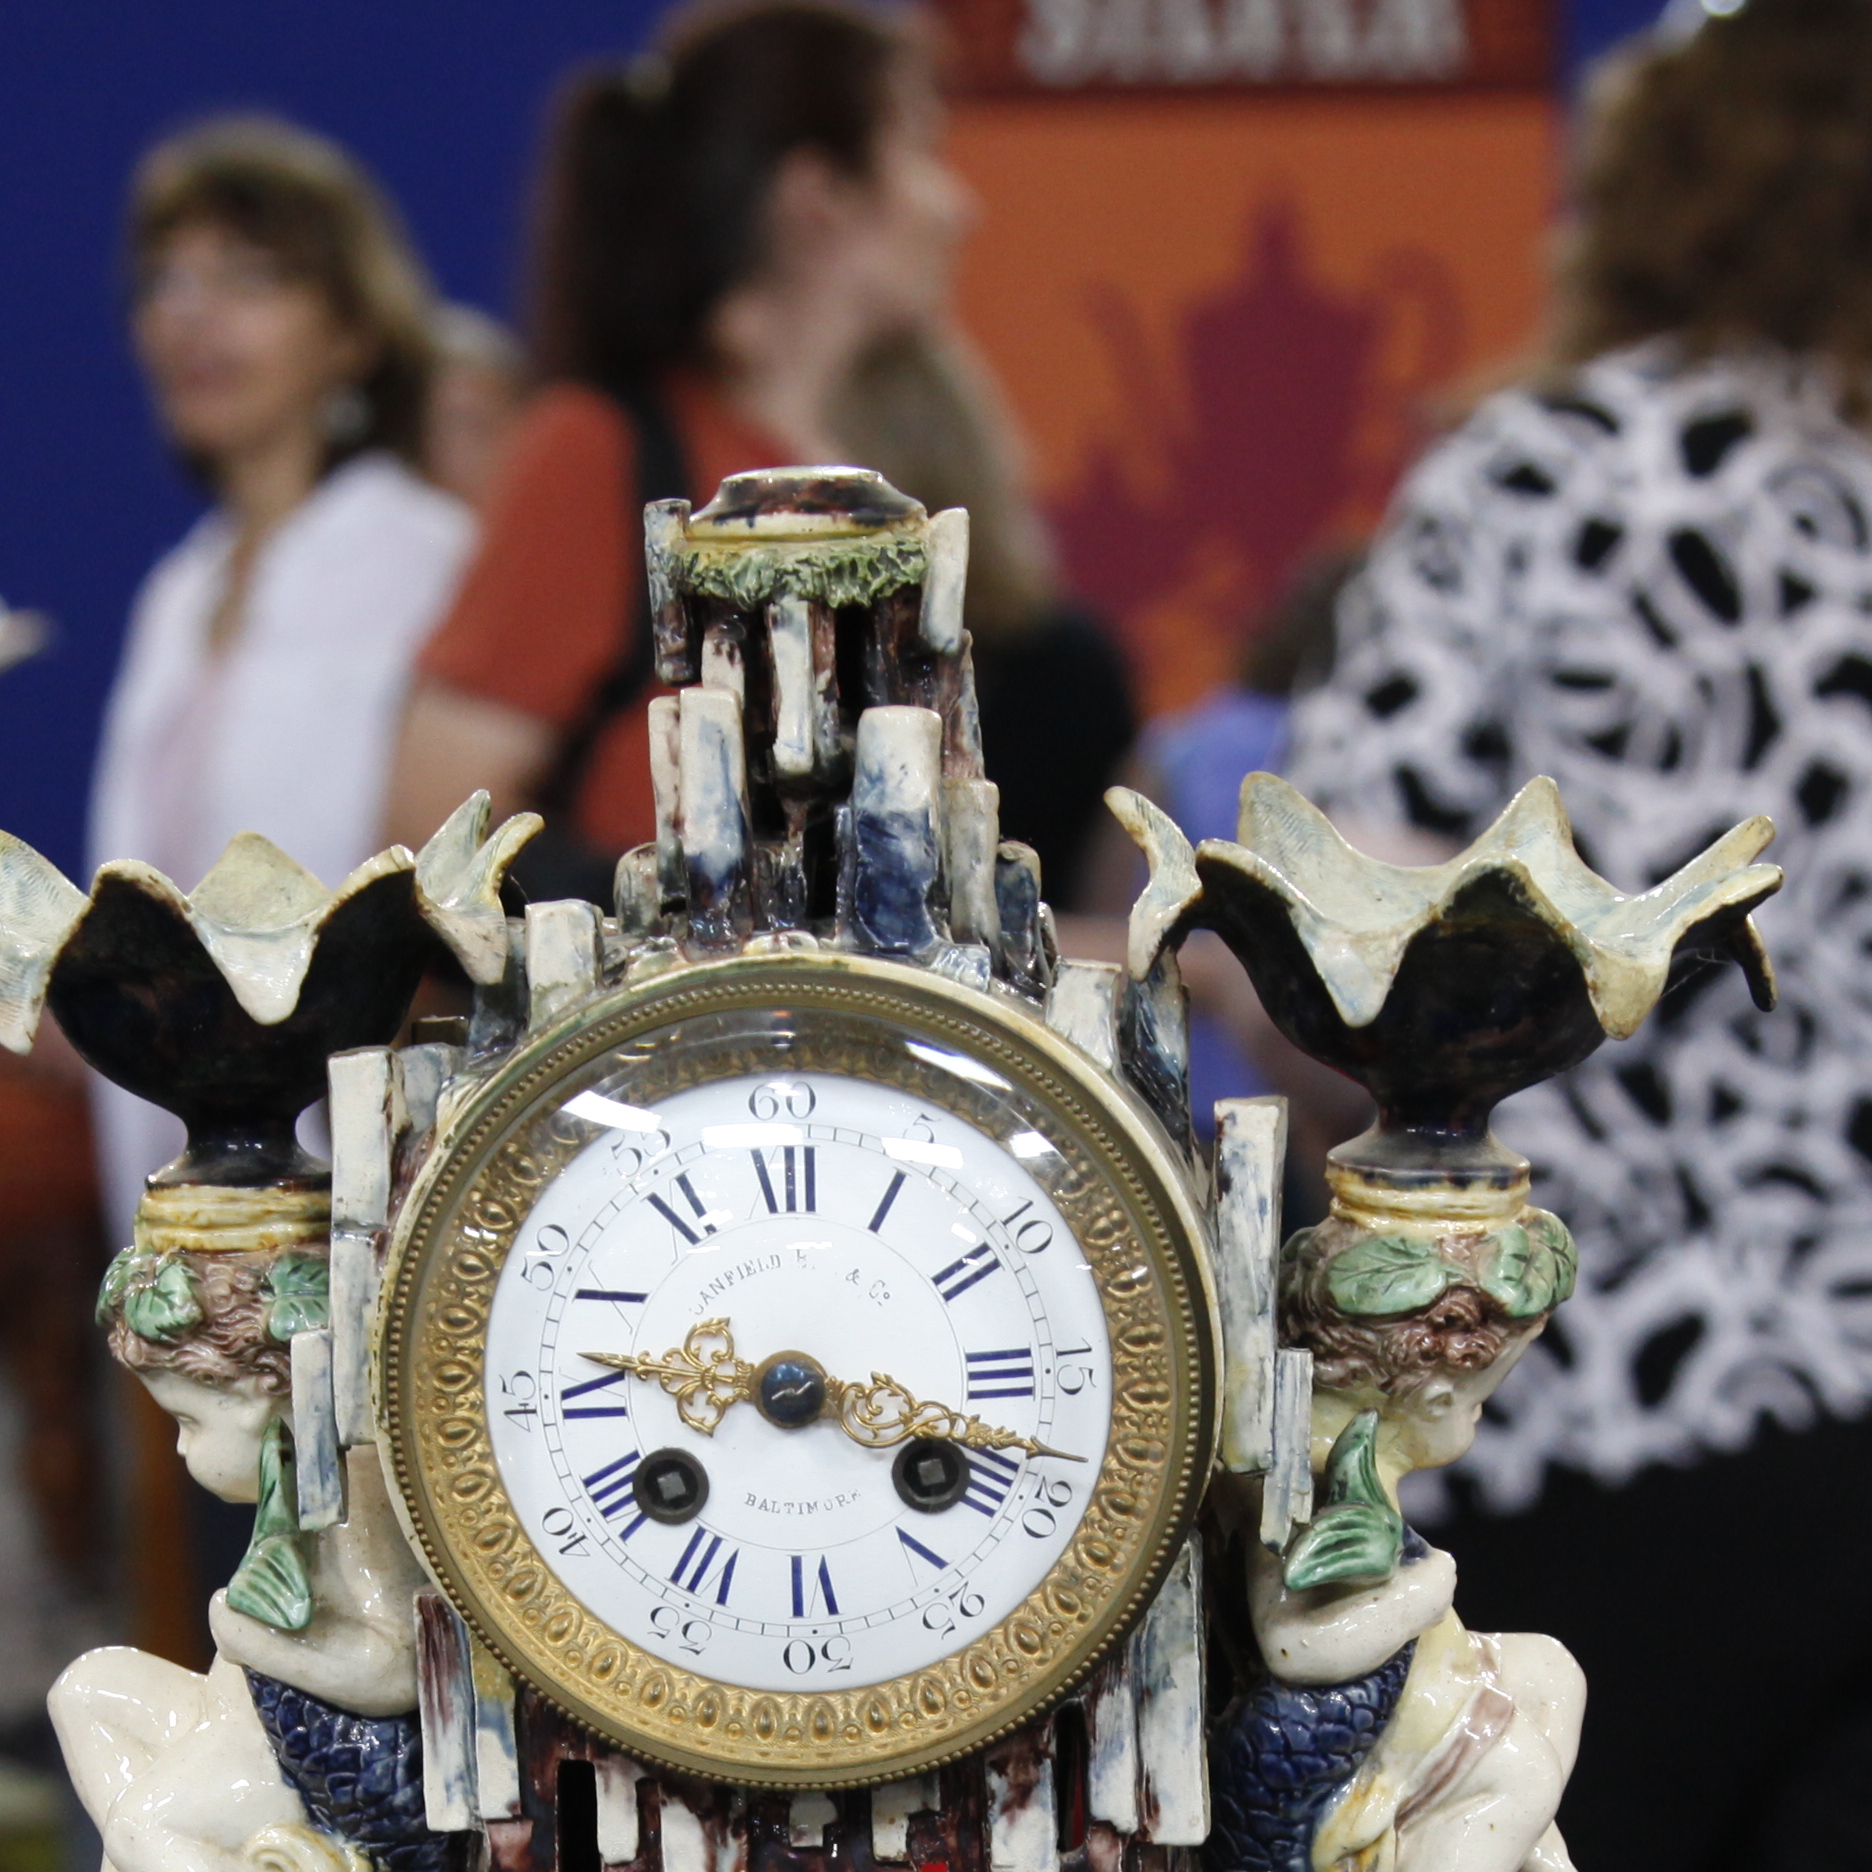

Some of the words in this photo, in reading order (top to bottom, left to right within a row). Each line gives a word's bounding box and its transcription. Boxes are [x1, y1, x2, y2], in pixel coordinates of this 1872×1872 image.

[747, 1080, 817, 1121] 60
[610, 1127, 672, 1178] 55
[743, 1144, 822, 1221] XII
[639, 1168, 721, 1266] XI
[1000, 1196, 1055, 1255] 10
[519, 1223, 571, 1293] 50
[926, 1239, 1007, 1308] II
[571, 1259, 654, 1336] X
[558, 1365, 631, 1427] IX
[962, 1341, 1037, 1403] III
[1055, 1336, 1098, 1396] 15
[498, 1369, 539, 1433] 45
[541, 1506, 592, 1558] 40
[1020, 1475, 1074, 1540] 20
[663, 1521, 741, 1609] VII
[786, 1553, 846, 1620] VI
[894, 1525, 955, 1588] V
[646, 1605, 713, 1657] 35
[921, 1580, 986, 1641] 25
[782, 1635, 855, 1676] 30
